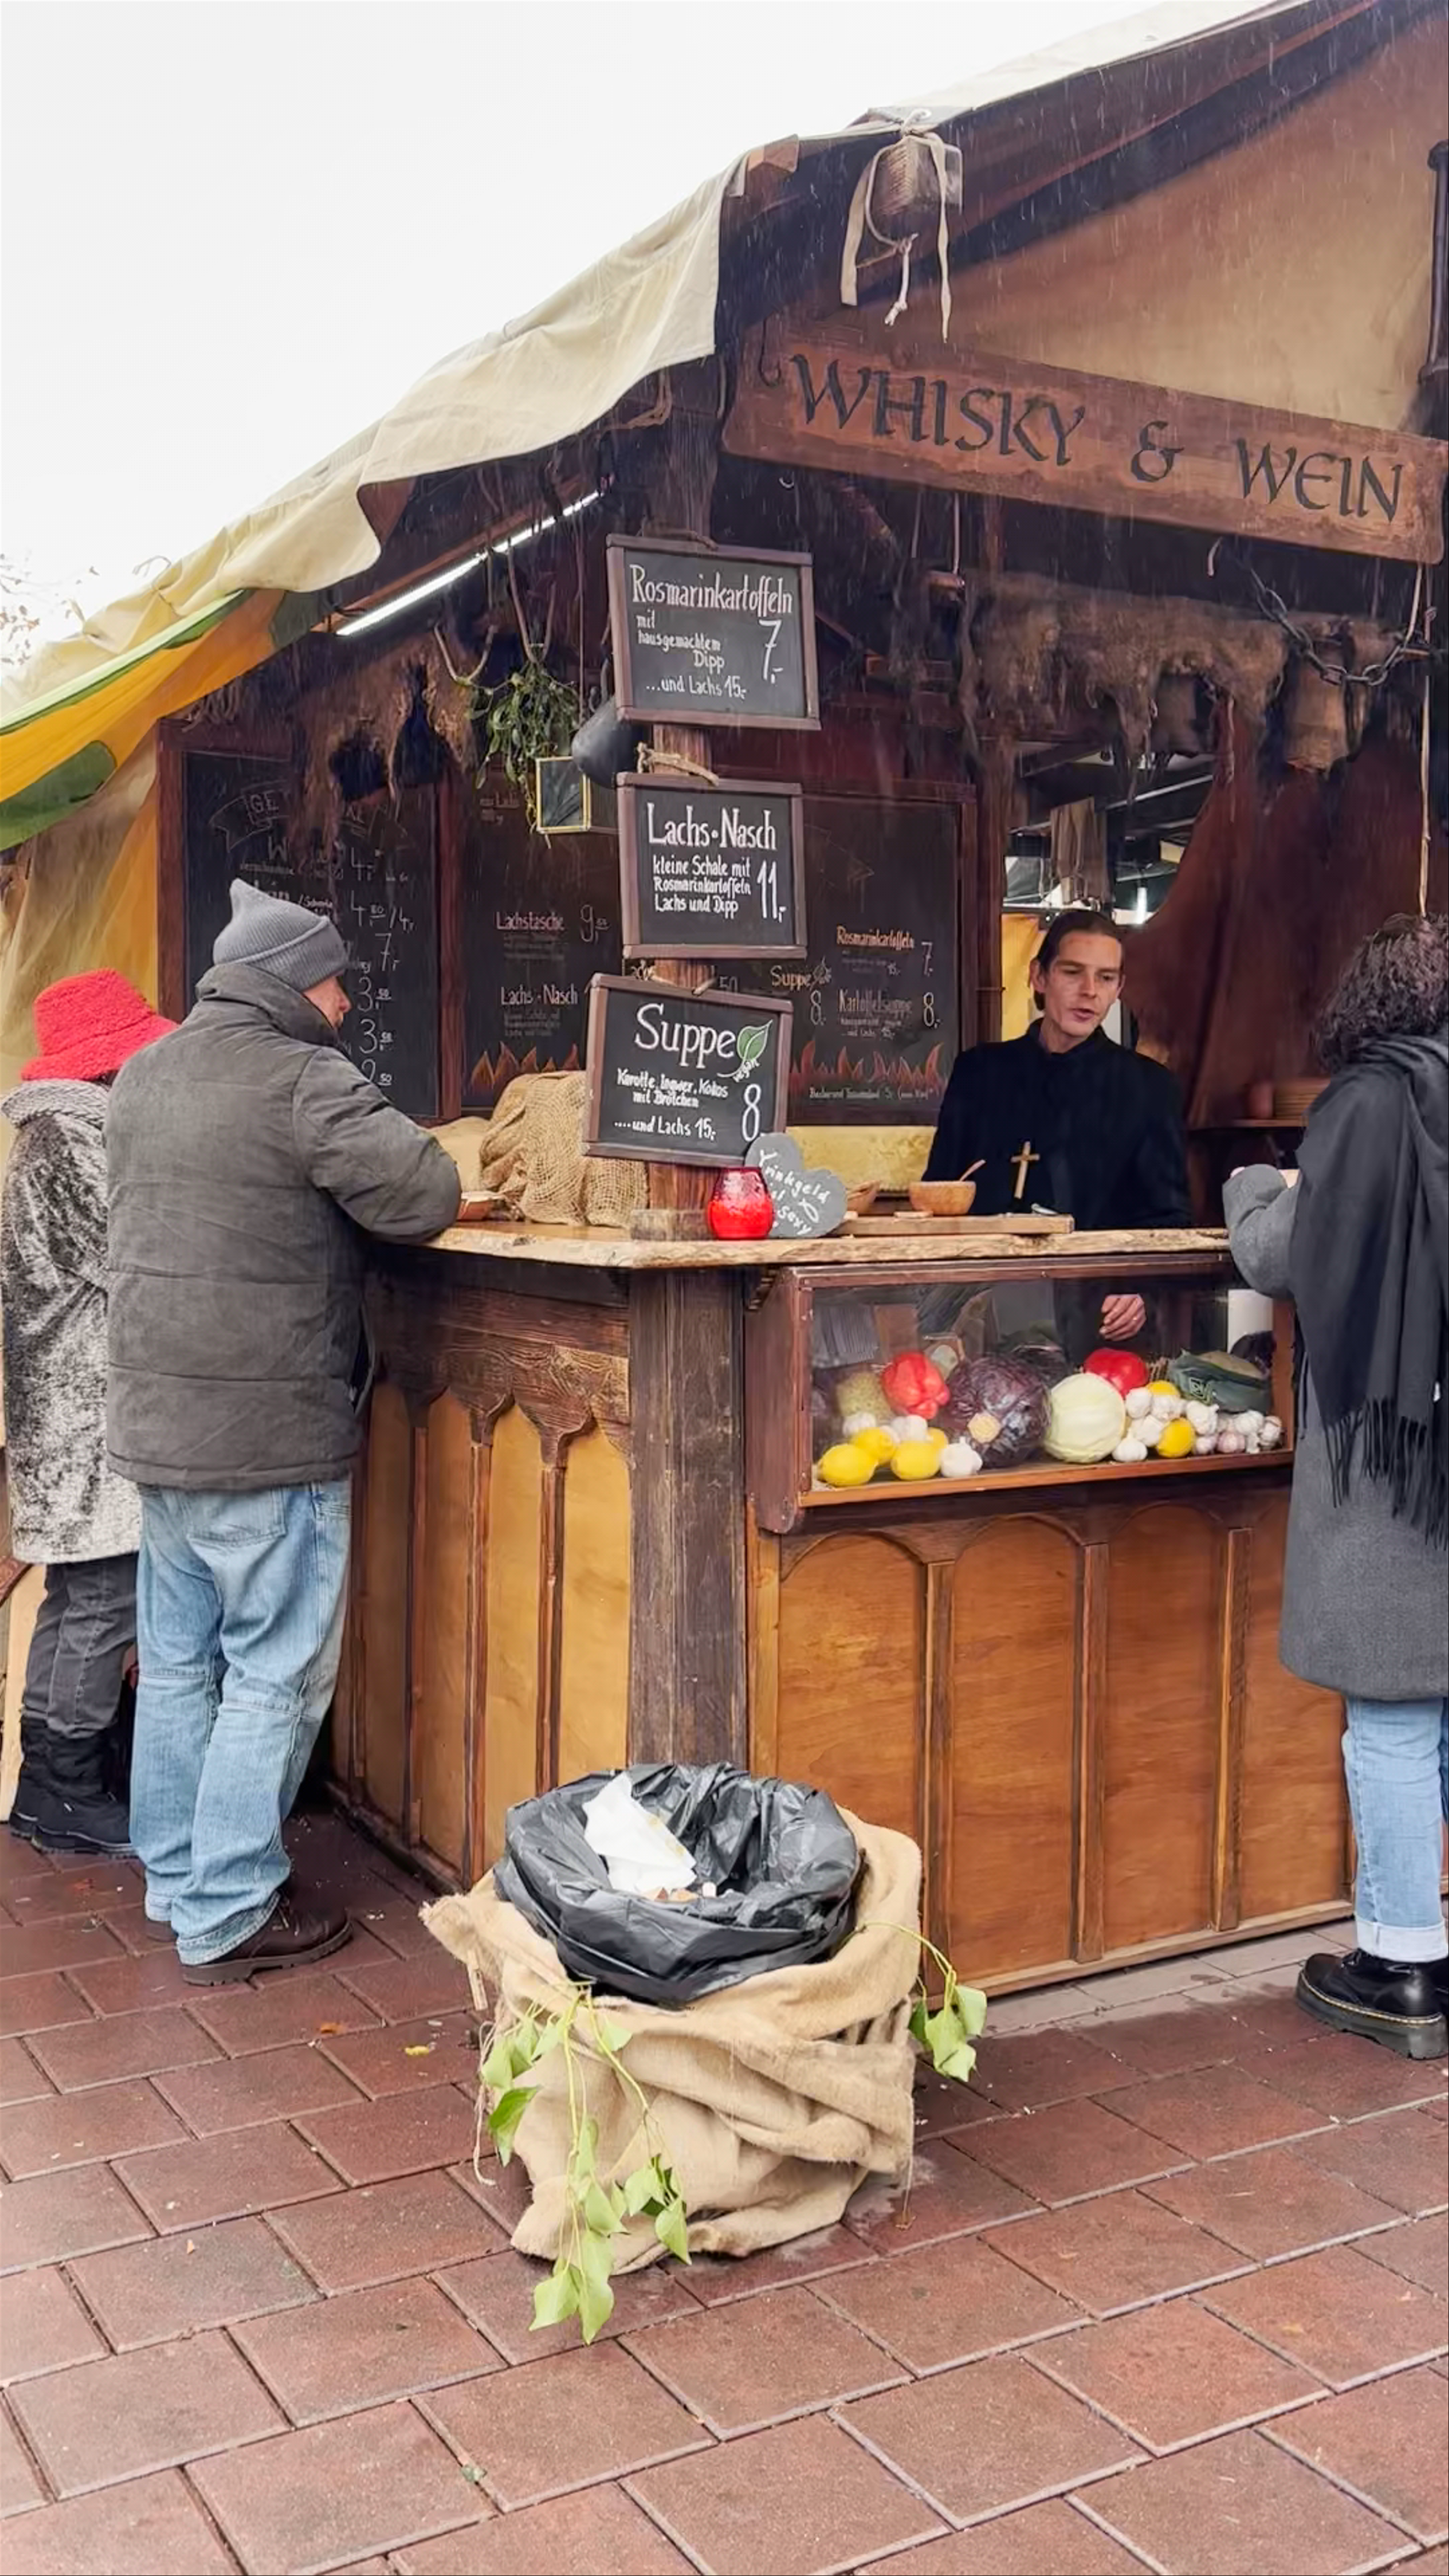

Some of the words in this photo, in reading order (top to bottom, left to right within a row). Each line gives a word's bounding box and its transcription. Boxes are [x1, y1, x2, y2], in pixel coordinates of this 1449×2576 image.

[791, 353, 1085, 466] WHISKY
[1131, 420, 1186, 483] &
[1236, 437, 1404, 524] WEIN
[630, 564, 792, 617] Rosmarinkartoffeln
[636, 610, 655, 629] mit
[693, 650, 724, 674] Dipp
[689, 676, 722, 697] Lachs
[653, 855, 688, 875] kleine
[692, 855, 728, 876] Schale
[731, 856, 751, 877] mit
[654, 876, 751, 899] Rosmarinkartoffeln
[655, 894, 687, 912] Lachs
[689, 895, 711, 912] und
[713, 895, 738, 919] Dipp
[771, 965, 812, 991] Suppe
[635, 1003, 735, 1069] Suppe
[632, 1088, 651, 1103] mit
[658, 1115, 691, 1136] Lachs
